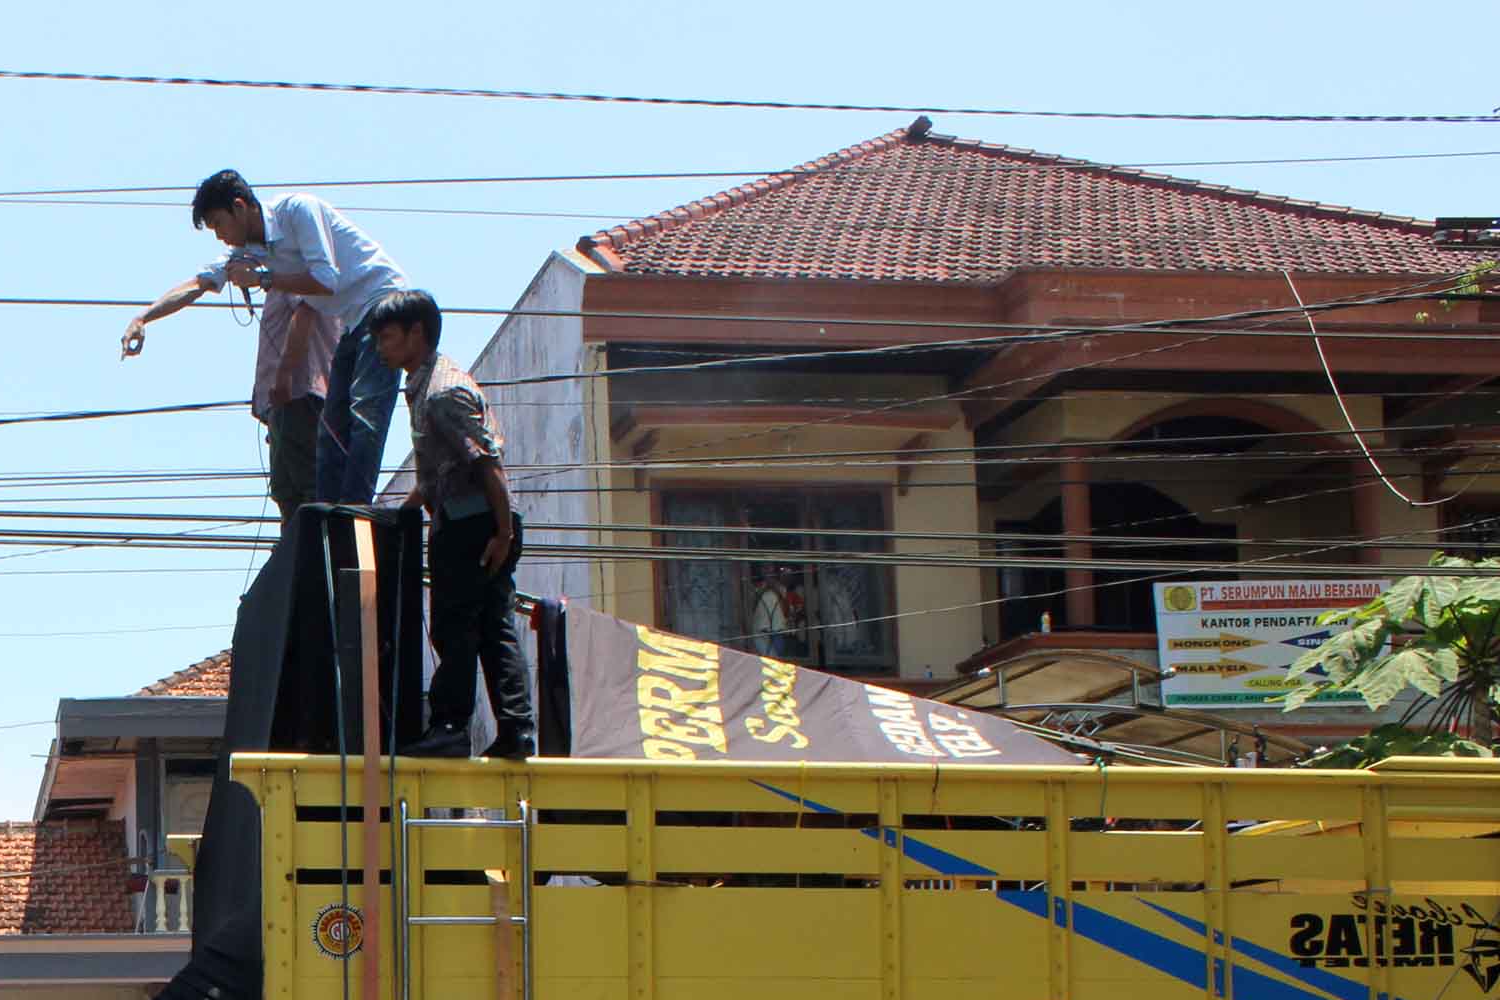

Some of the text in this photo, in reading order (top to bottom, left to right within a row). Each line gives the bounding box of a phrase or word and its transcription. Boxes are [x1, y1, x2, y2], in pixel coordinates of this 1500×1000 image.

[1201, 584, 1381, 599] PT. SERUMPUN MAJU BERSAMA
[1201, 615, 1348, 629] KANTOR PENDAFTAN
[1173, 638, 1252, 648] HONGKONG
[1176, 663, 1248, 673] MALAYSIA
